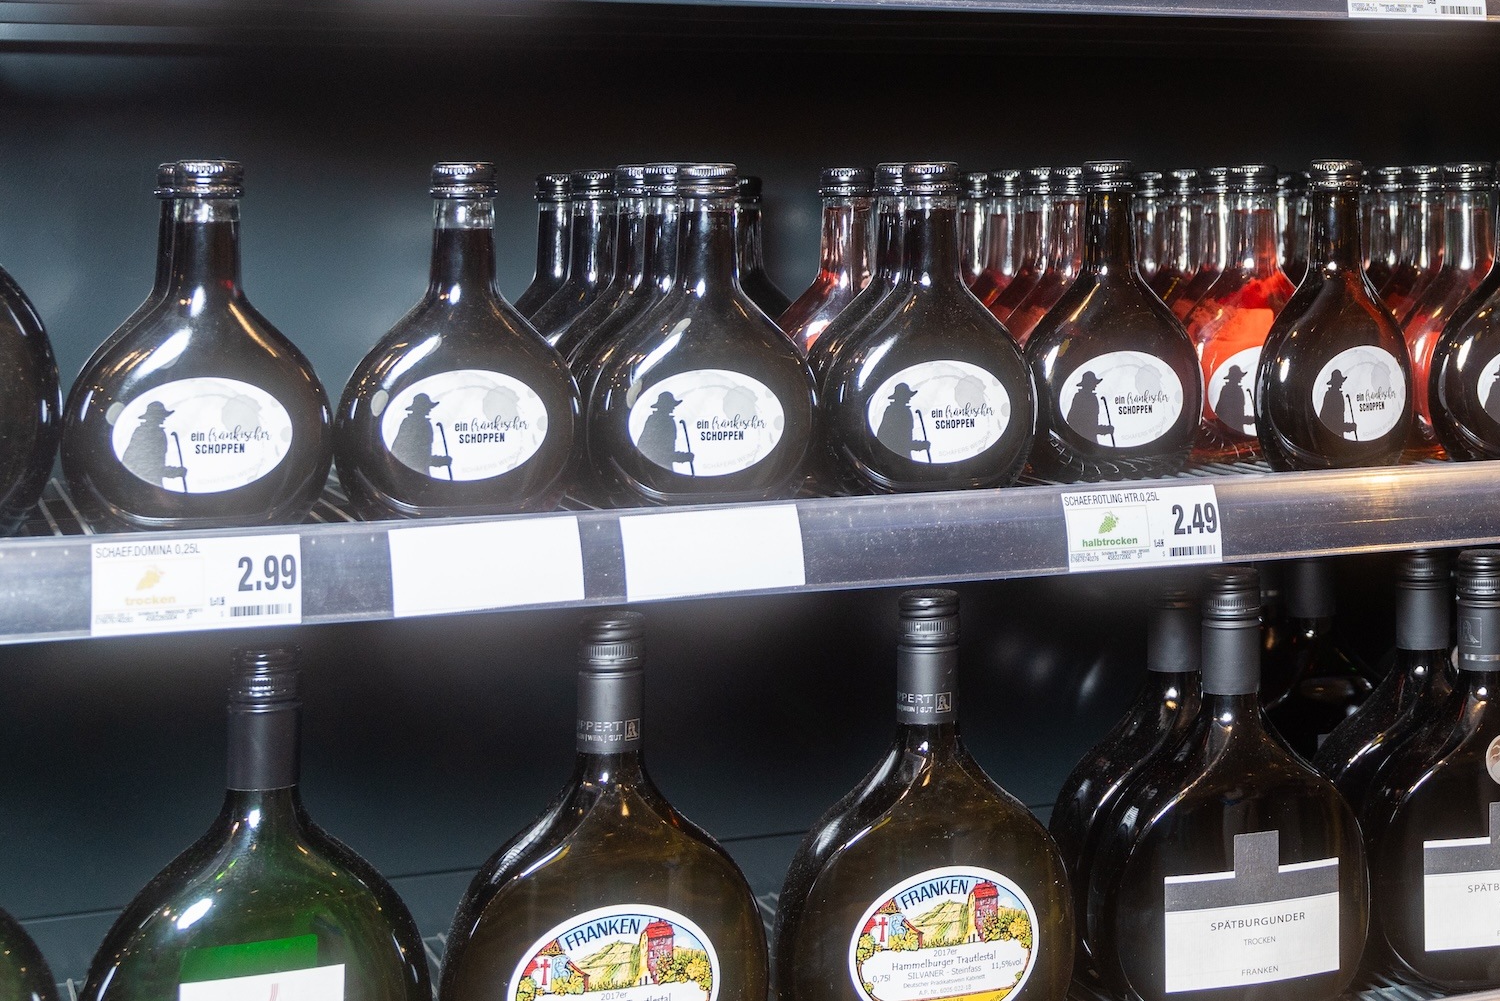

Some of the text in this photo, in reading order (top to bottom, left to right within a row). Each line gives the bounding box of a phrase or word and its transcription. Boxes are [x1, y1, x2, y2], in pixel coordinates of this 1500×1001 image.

[1114, 396, 1125, 404] ein
[931, 408, 943, 418] ein
[1118, 405, 1153, 415] SCHOPPEN
[454, 422, 468, 431] ein
[696, 419, 709, 429] ein
[935, 419, 975, 429] SCHOPPEN
[191, 431, 205, 441] ein
[459, 433, 505, 444] SCHOPPEN
[700, 431, 744, 441] SCHOPPEN
[195, 443, 245, 454] SCHOPPEN
[1064, 493, 1123, 506] SCHAEF.ROTLING
[1171, 502, 1218, 535] 2.49
[1082, 536, 1138, 547] halbtrocken
[237, 554, 297, 592] 2.99
[125, 595, 176, 606] trocken
[900, 879, 969, 910] FRANKEN
[1210, 911, 1306, 931] SPÄTBURGUNDER
[564, 918, 640, 951] FRANKEN
[1243, 935, 1276, 946] TROCKEN
[933, 948, 958, 957] 2017er
[892, 951, 996, 971] Hammelburger Trautlestal
[907, 970, 944, 980] SILVANER
[951, 965, 982, 976] Steinfass
[1241, 965, 1279, 976] FRANKEN
[903, 980, 929, 989] Deutscher
[600, 990, 628, 1001] 2017er
